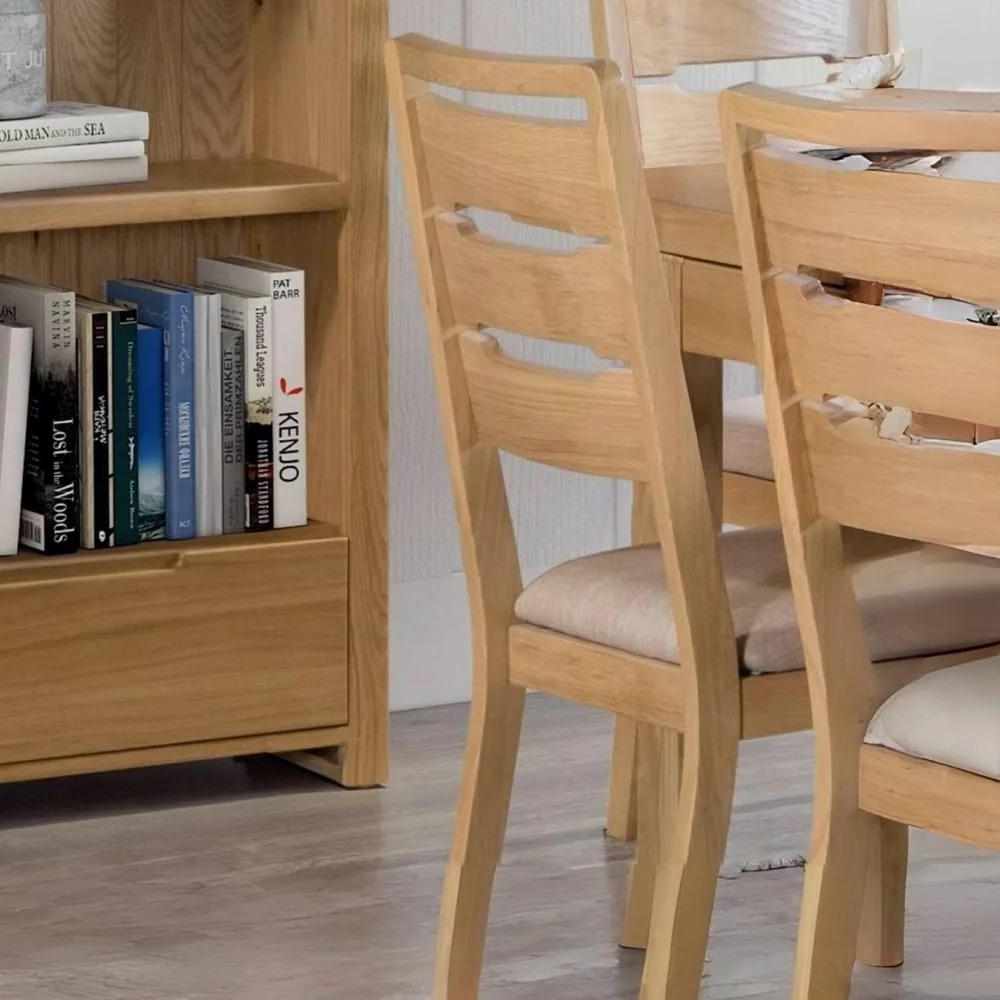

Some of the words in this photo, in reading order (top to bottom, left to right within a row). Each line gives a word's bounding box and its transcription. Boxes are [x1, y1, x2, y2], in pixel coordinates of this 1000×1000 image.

[25, 126, 50, 140] MAN
[84, 122, 105, 136] SEA
[273, 279, 290, 288] PAT
[273, 289, 300, 300] BARR
[51, 301, 61, 350] NAVINA
[62, 300, 71, 349] MARVIN
[256, 305, 267, 350] Thousand
[234, 336, 244, 429] PRIMZAHLEN
[254, 350, 267, 388] Leagues
[224, 350, 233, 436] EINSAMKEIT
[52, 418, 74, 457] Lost
[224, 442, 233, 464] DIE
[234, 432, 243, 463] DER
[278, 411, 300, 482] KENJO
[53, 461, 63, 469] in
[53, 471, 63, 484] the
[53, 482, 75, 543] Woods
